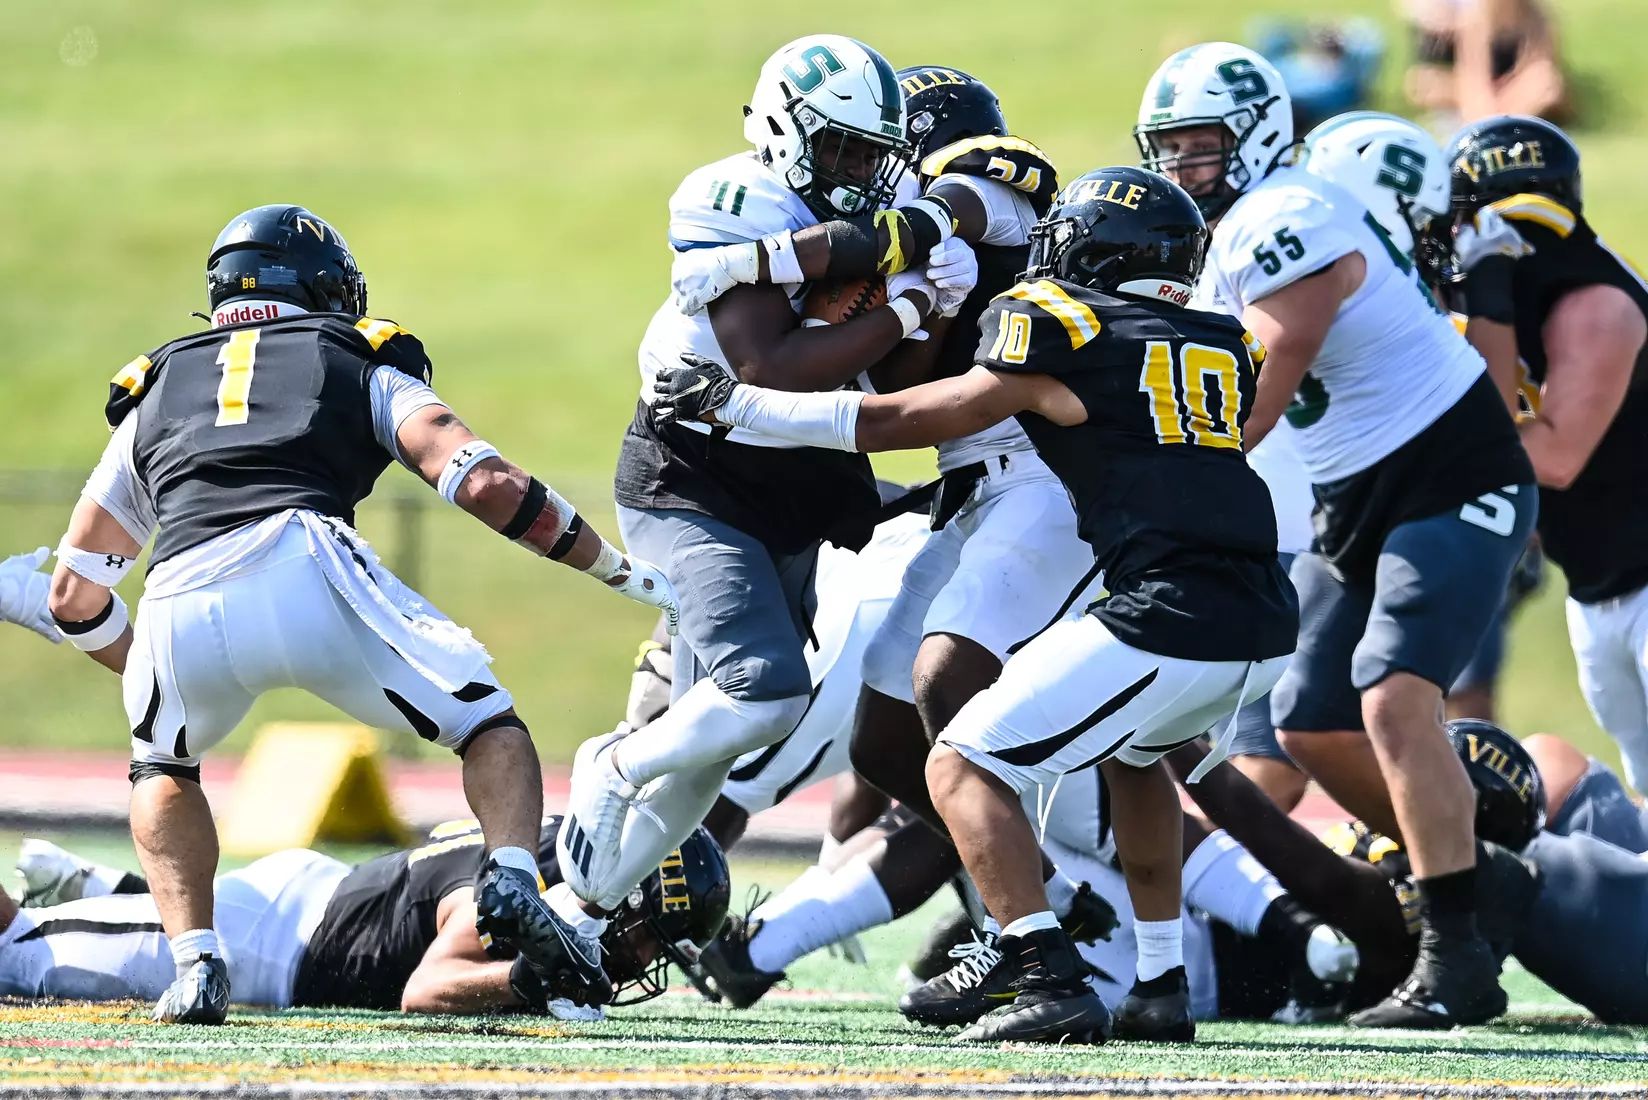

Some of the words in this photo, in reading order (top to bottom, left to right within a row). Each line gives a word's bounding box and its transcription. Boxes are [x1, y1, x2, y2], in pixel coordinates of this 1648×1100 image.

[780, 45, 846, 95] S
[900, 70, 967, 101] ILLE
[1216, 57, 1269, 106] S
[1374, 142, 1427, 197] S
[1064, 179, 1148, 211] VILLE
[1252, 226, 1305, 276] 55
[242, 277, 256, 289] 88
[1158, 283, 1191, 306] Ridd
[217, 305, 279, 326] Riddell
[988, 309, 1032, 365] 10
[215, 328, 261, 427] 1
[1139, 341, 1243, 452] 10
[1466, 733, 1531, 804] VILLE
